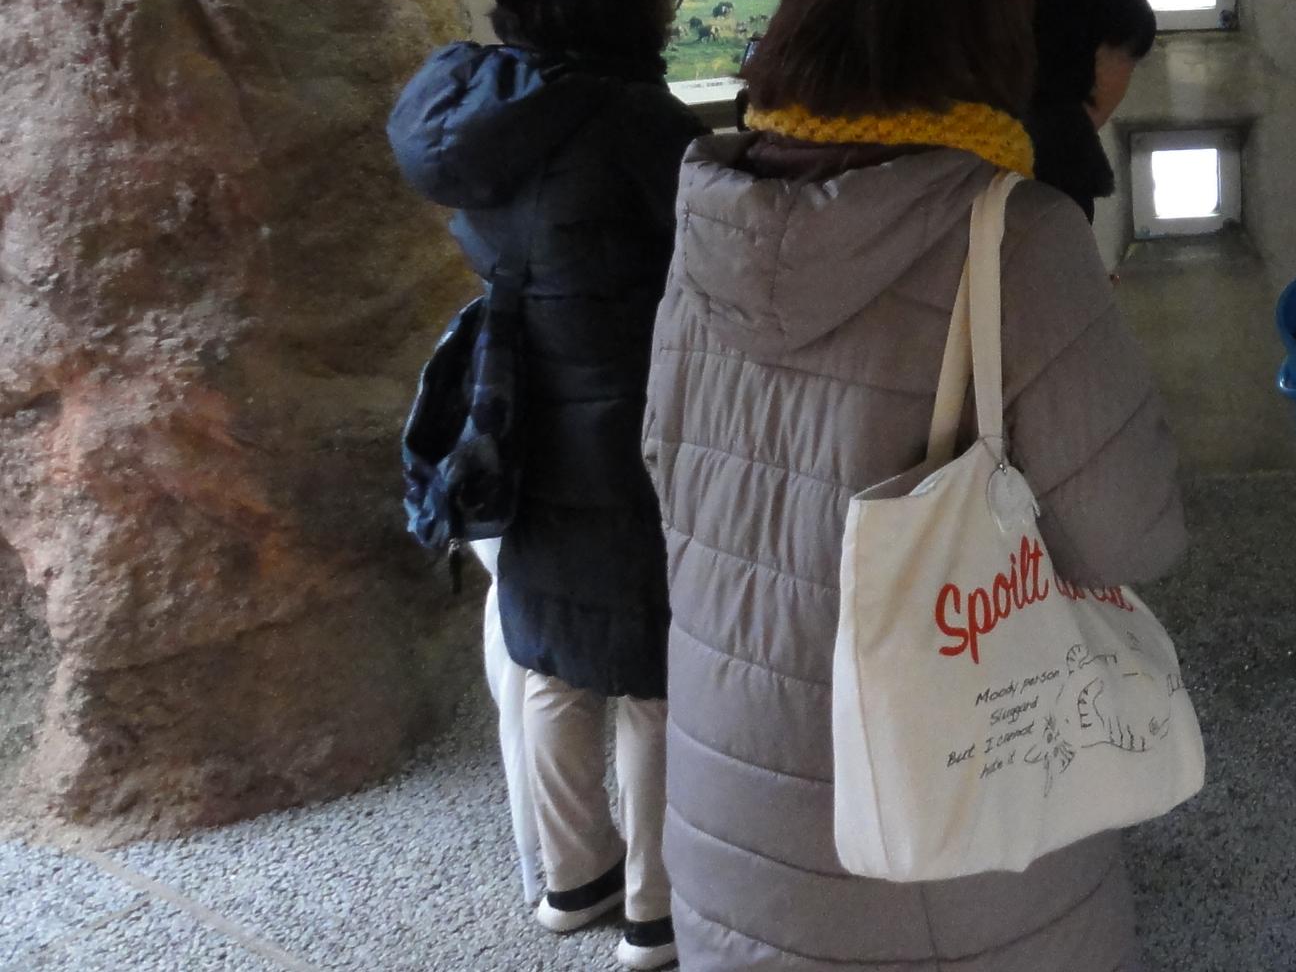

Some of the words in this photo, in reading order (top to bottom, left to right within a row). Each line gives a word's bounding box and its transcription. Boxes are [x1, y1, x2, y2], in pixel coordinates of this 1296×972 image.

[935, 534, 1049, 665] Spoilt
[975, 680, 1018, 706] Moody
[1020, 670, 1061, 694] person
[947, 743, 976, 767] But
[984, 736, 994, 754] I
